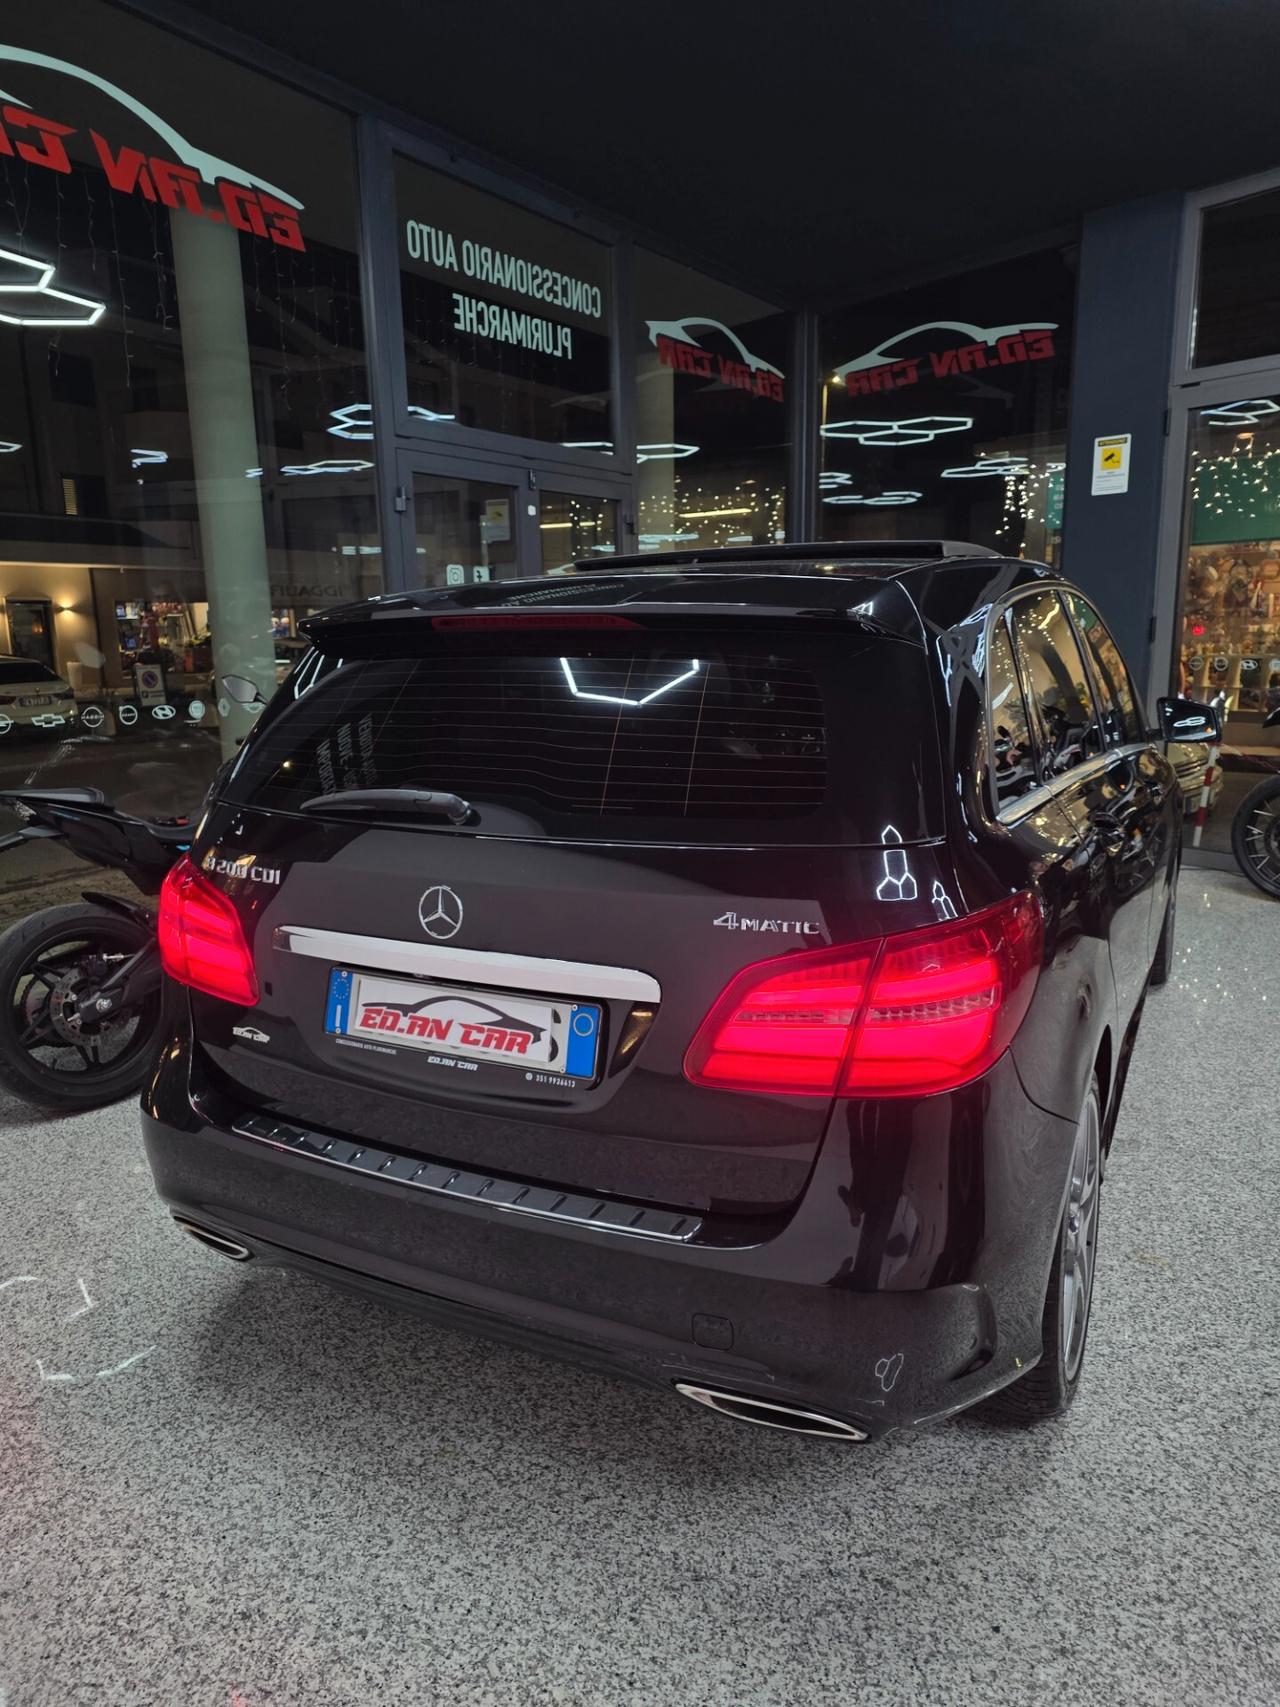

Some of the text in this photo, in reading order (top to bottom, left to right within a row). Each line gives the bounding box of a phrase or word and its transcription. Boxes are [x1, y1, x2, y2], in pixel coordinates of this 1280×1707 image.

[251, 865, 281, 885] CDI
[713, 911, 820, 935] 4MATIC
[360, 1007, 531, 1054] ED.AN CAR
[456, 1062, 479, 1072] CAR
[535, 1074, 547, 1084] 351
